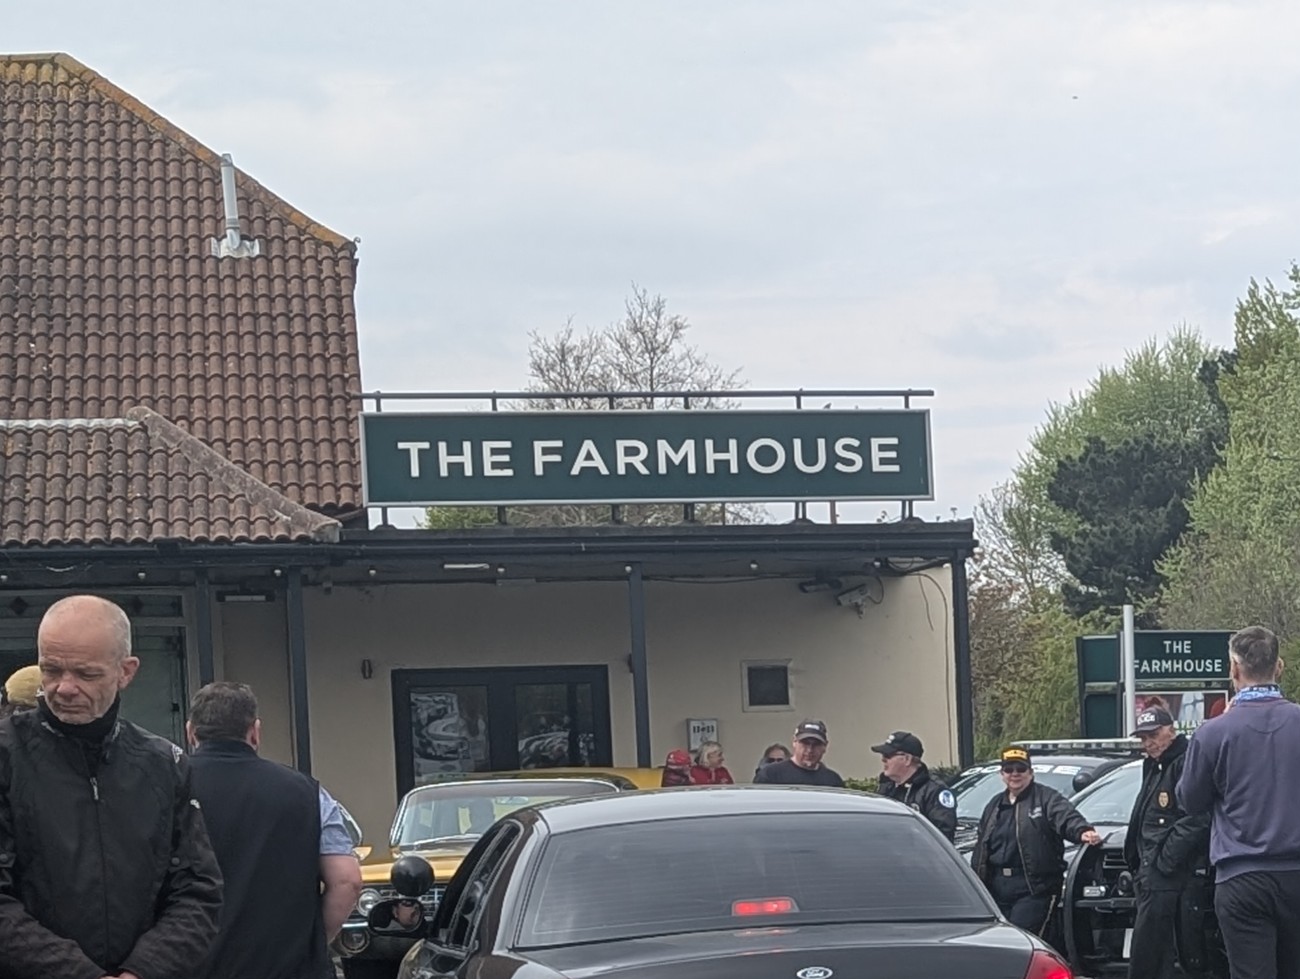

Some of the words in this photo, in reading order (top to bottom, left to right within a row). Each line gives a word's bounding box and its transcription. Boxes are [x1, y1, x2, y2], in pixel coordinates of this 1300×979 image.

[397, 439, 515, 478] THE
[532, 436, 901, 477] FARMHOUSE
[1163, 640, 1191, 653] THE
